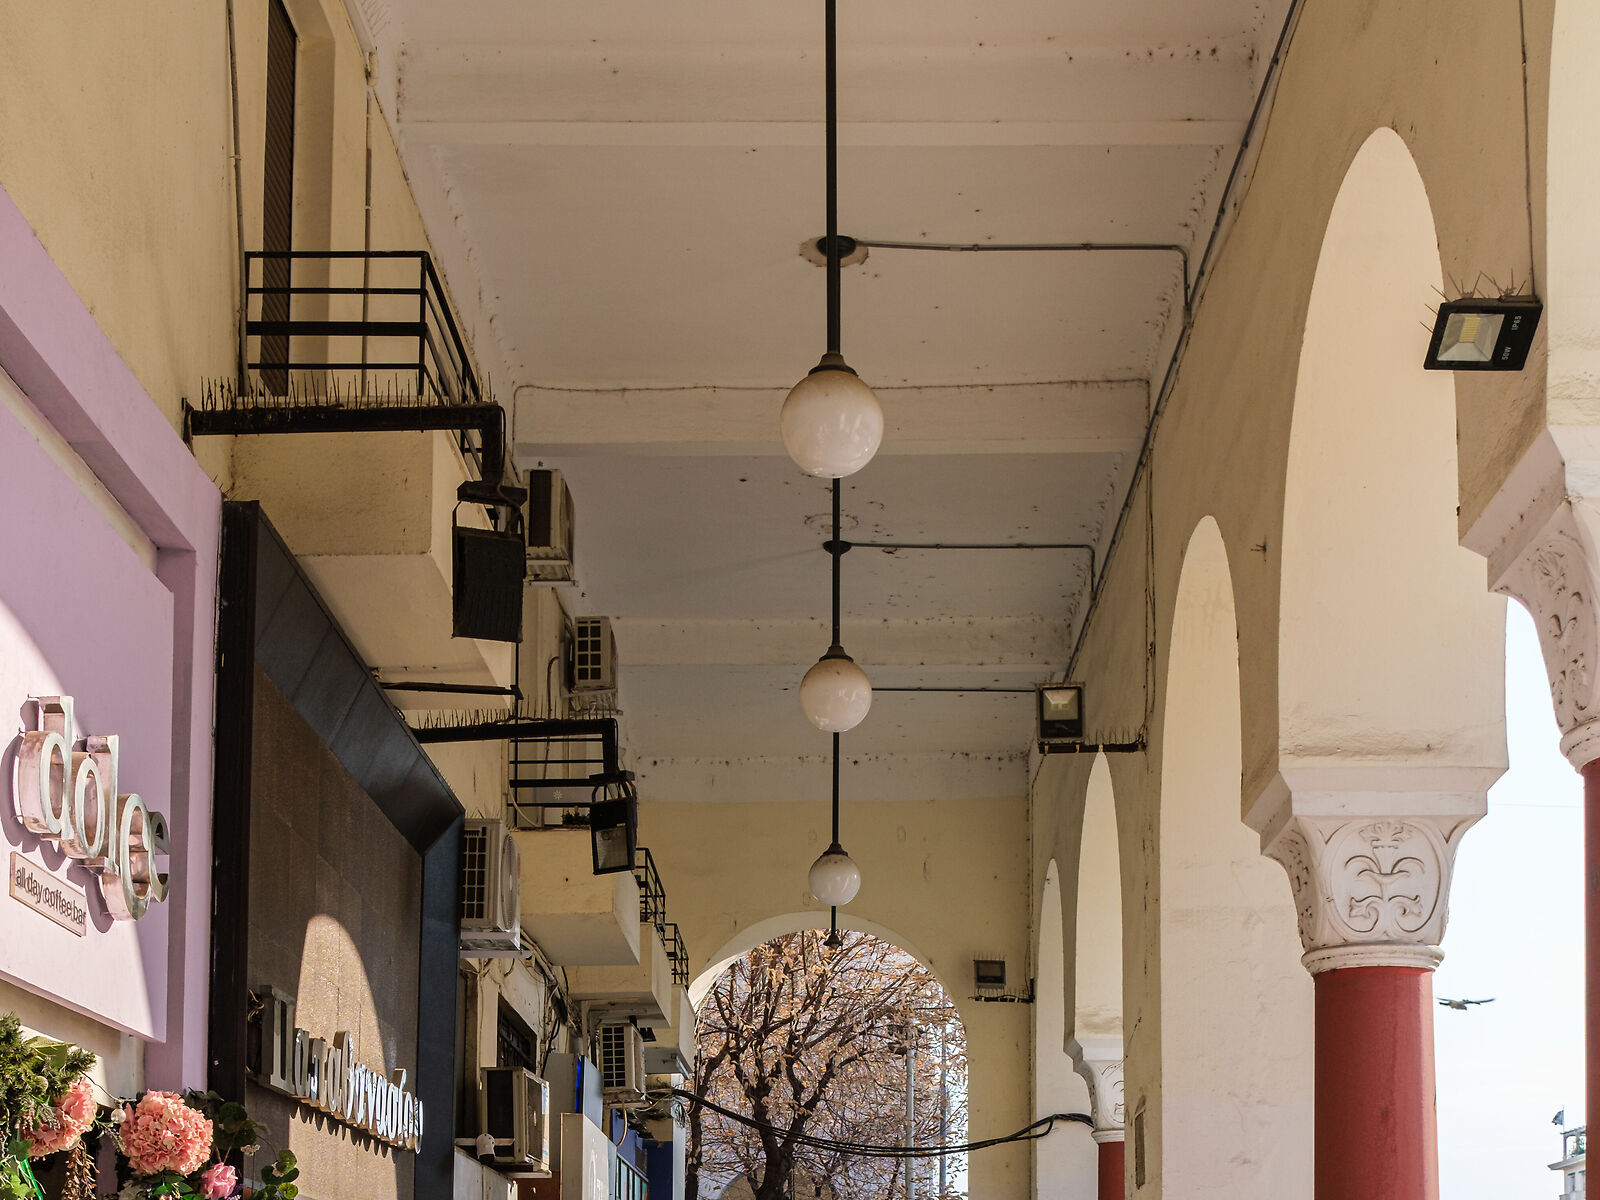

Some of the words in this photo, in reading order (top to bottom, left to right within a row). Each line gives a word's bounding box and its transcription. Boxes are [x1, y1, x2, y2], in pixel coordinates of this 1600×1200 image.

[28, 694, 170, 922] dolce
[16, 867, 26, 888] all
[26, 872, 43, 904] day
[43, 887, 72, 917] coffee
[72, 900, 87, 926] bar
